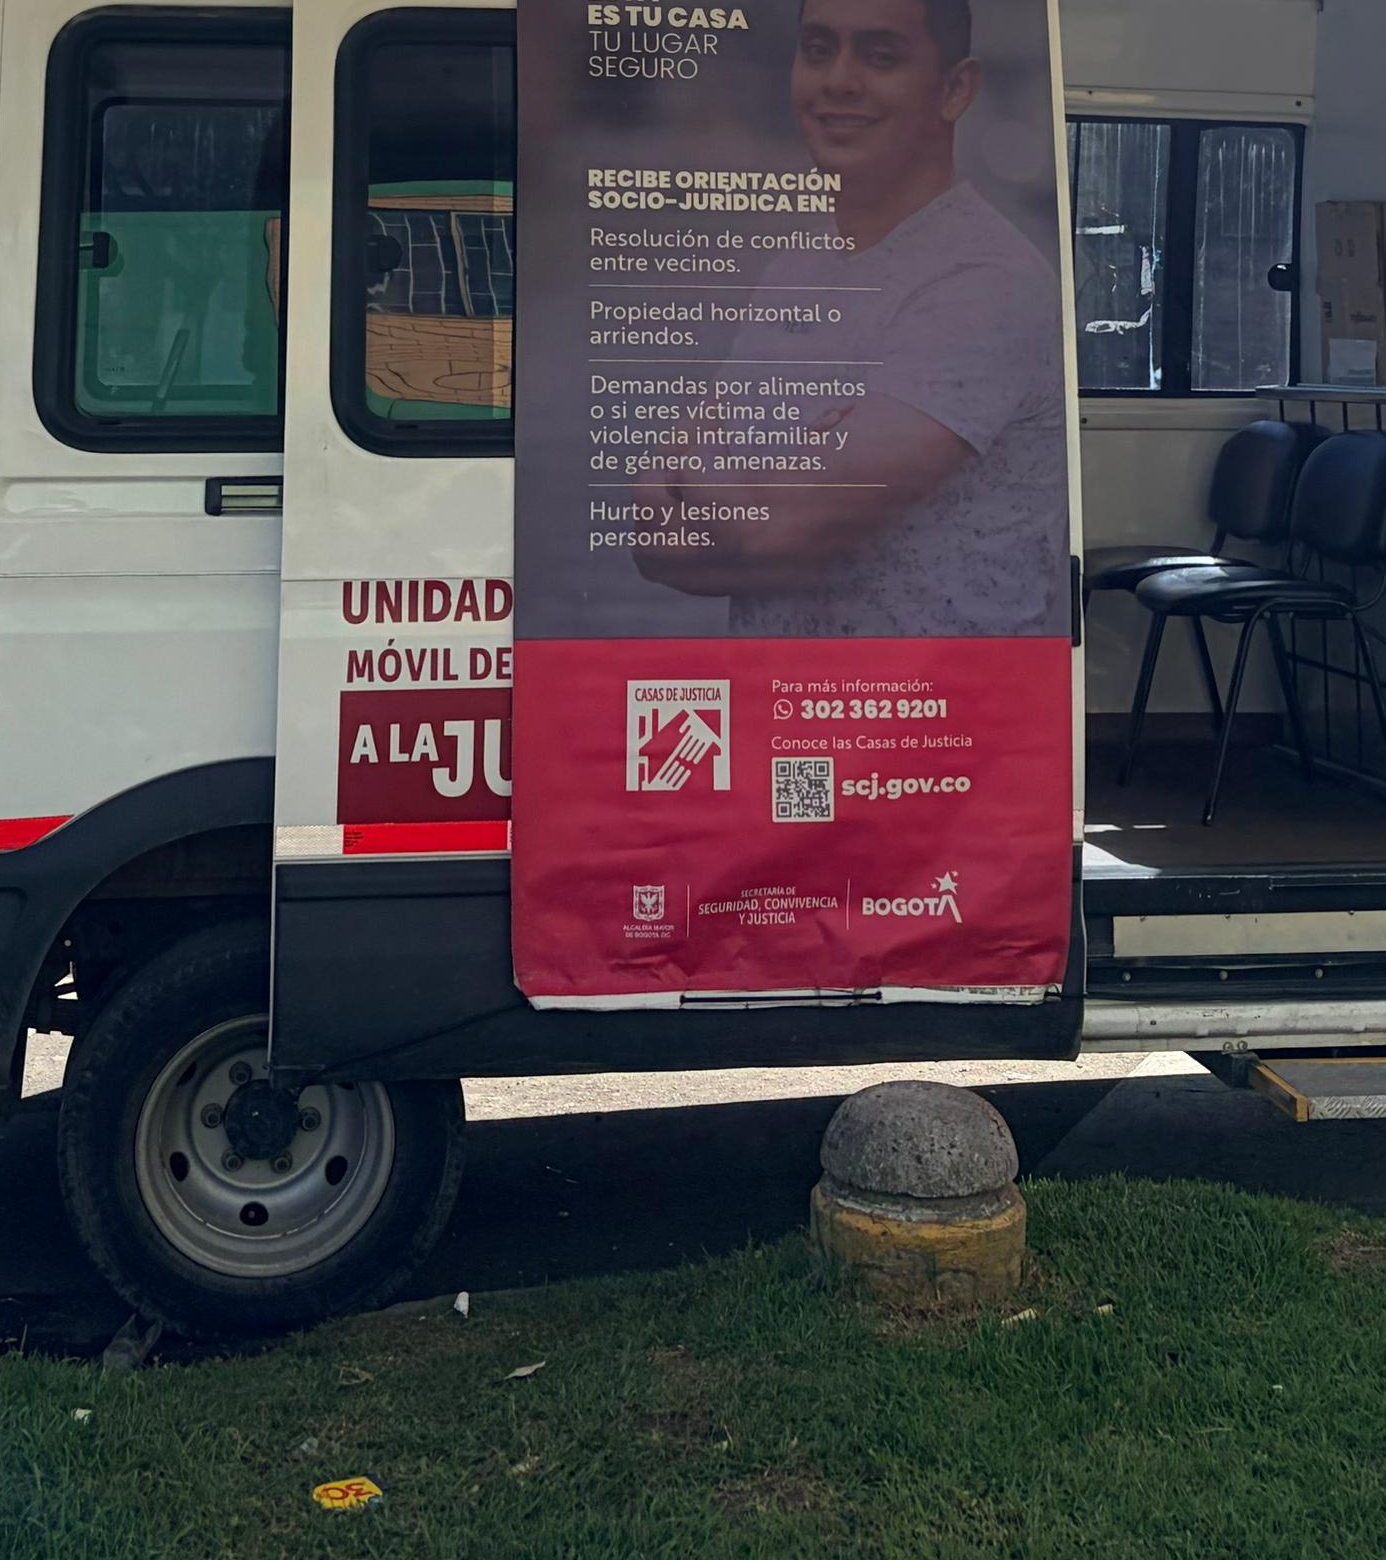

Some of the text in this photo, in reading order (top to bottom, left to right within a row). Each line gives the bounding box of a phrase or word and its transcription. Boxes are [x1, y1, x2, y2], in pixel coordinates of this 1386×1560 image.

[587, 4, 749, 30] ES TU CASA
[589, 30, 718, 55] TU LUGAR
[589, 55, 698, 79] SEGURO
[588, 168, 841, 192] RECIBE ORIENTACIÓN
[588, 186, 836, 213] SOCIO-JURÍDICA EN:
[590, 227, 856, 251] Resolución de conflictos
[590, 253, 741, 273] entre vecinos.
[590, 300, 842, 325] Propiedad horizontal o
[589, 327, 699, 346] arriendos.
[590, 375, 866, 400] Demandas por alimentos
[590, 400, 801, 421] o si eres víctima de
[589, 425, 849, 450] violencia intrafamiliar y
[590, 449, 828, 475] de género, amenazas.
[589, 501, 771, 526] Hurto y lesiones
[589, 527, 716, 552] personales.
[342, 579, 513, 624] UNIDAD
[347, 638, 513, 683] MÓVIL DE
[635, 687, 722, 703] CASAS DE JUSTICIA
[772, 679, 934, 694] Para más información:
[800, 698, 948, 720] 302 362 9201
[350, 724, 379, 763] A
[389, 722, 439, 763] LA
[771, 734, 973, 751] Conoce las Casas de Justicia
[841, 773, 972, 801] scj.gov.co
[787, 887, 796, 896] DE
[698, 896, 839, 916] SEGURIDAD, CONVIVENCIA
[739, 911, 796, 926] Y JUSTICIA
